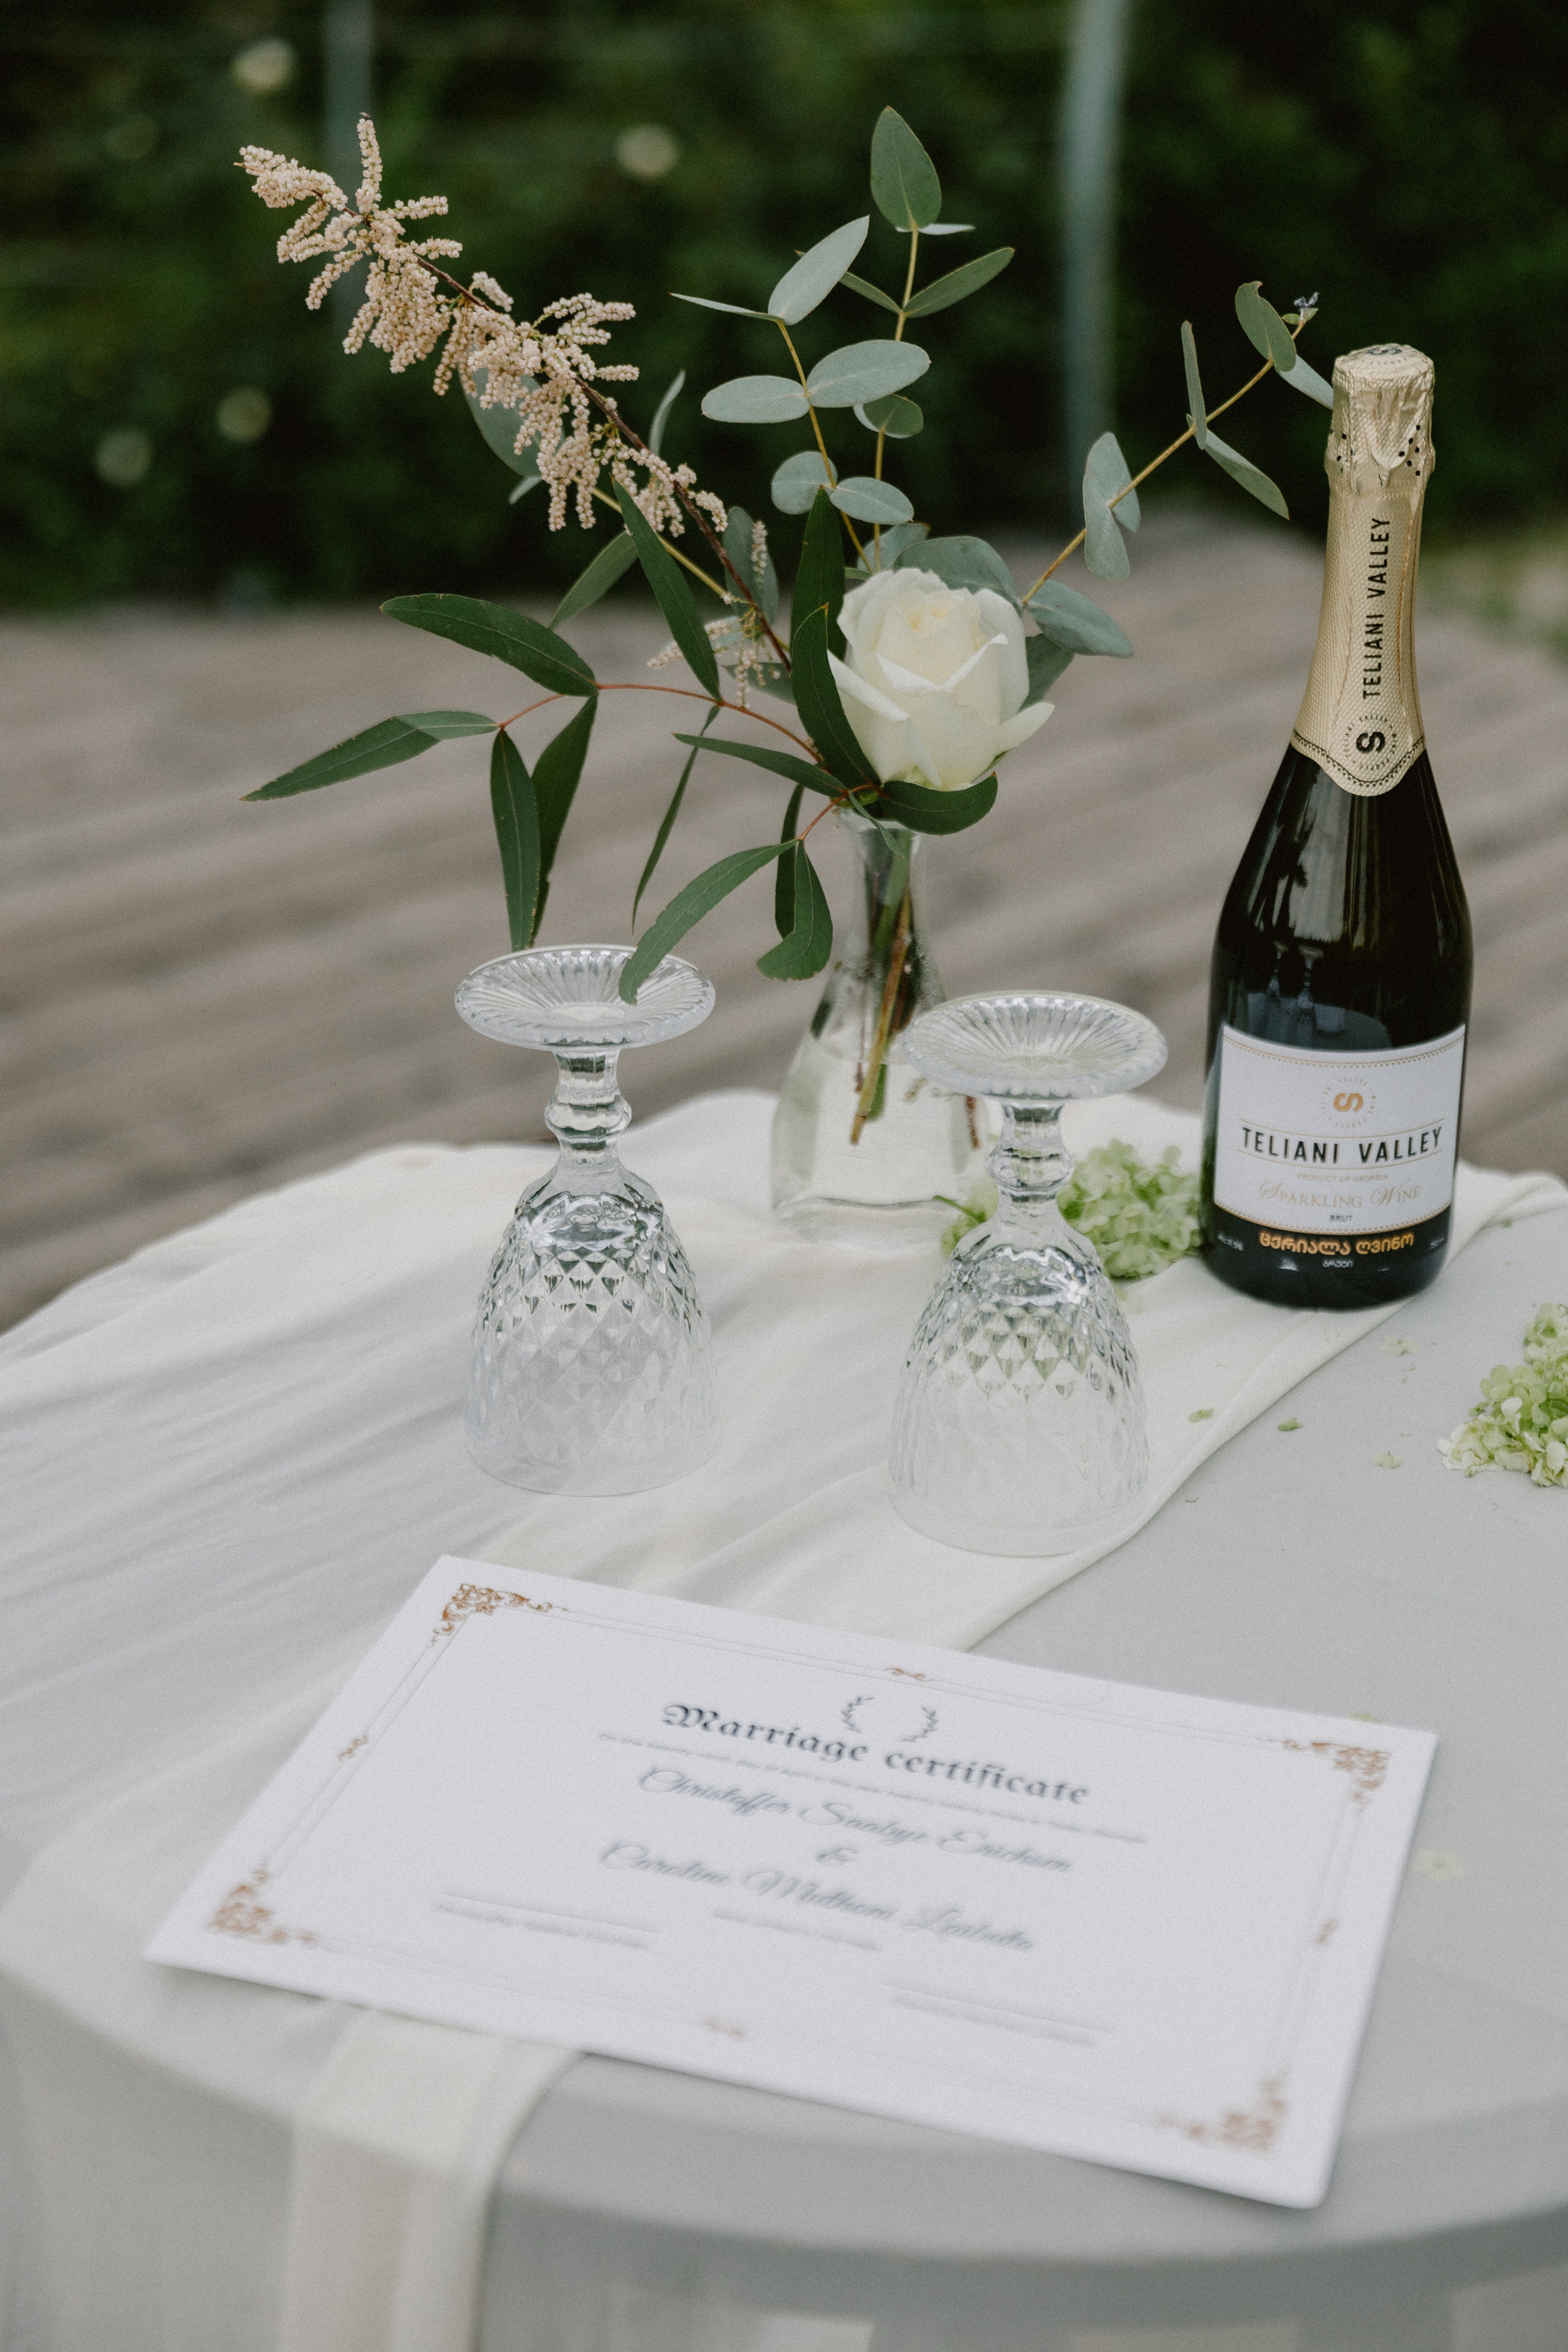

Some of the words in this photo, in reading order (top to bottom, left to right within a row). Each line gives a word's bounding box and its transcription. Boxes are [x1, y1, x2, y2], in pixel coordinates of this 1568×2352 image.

[1366, 517, 1390, 600] VALLEY
[1362, 613, 1384, 699] TELIANI
[1242, 1126, 1339, 1164] TELIANI
[1359, 1126, 1442, 1164] VALLEY
[1297, 1174, 1336, 1183] PRODUCT
[1352, 1174, 1389, 1183] GEORGIA
[1355, 1232, 1414, 1255] ღვინო
[662, 1704, 869, 1763] Marriage
[884, 1747, 1090, 1806] certificate
[638, 1766, 792, 1817] Christoffer
